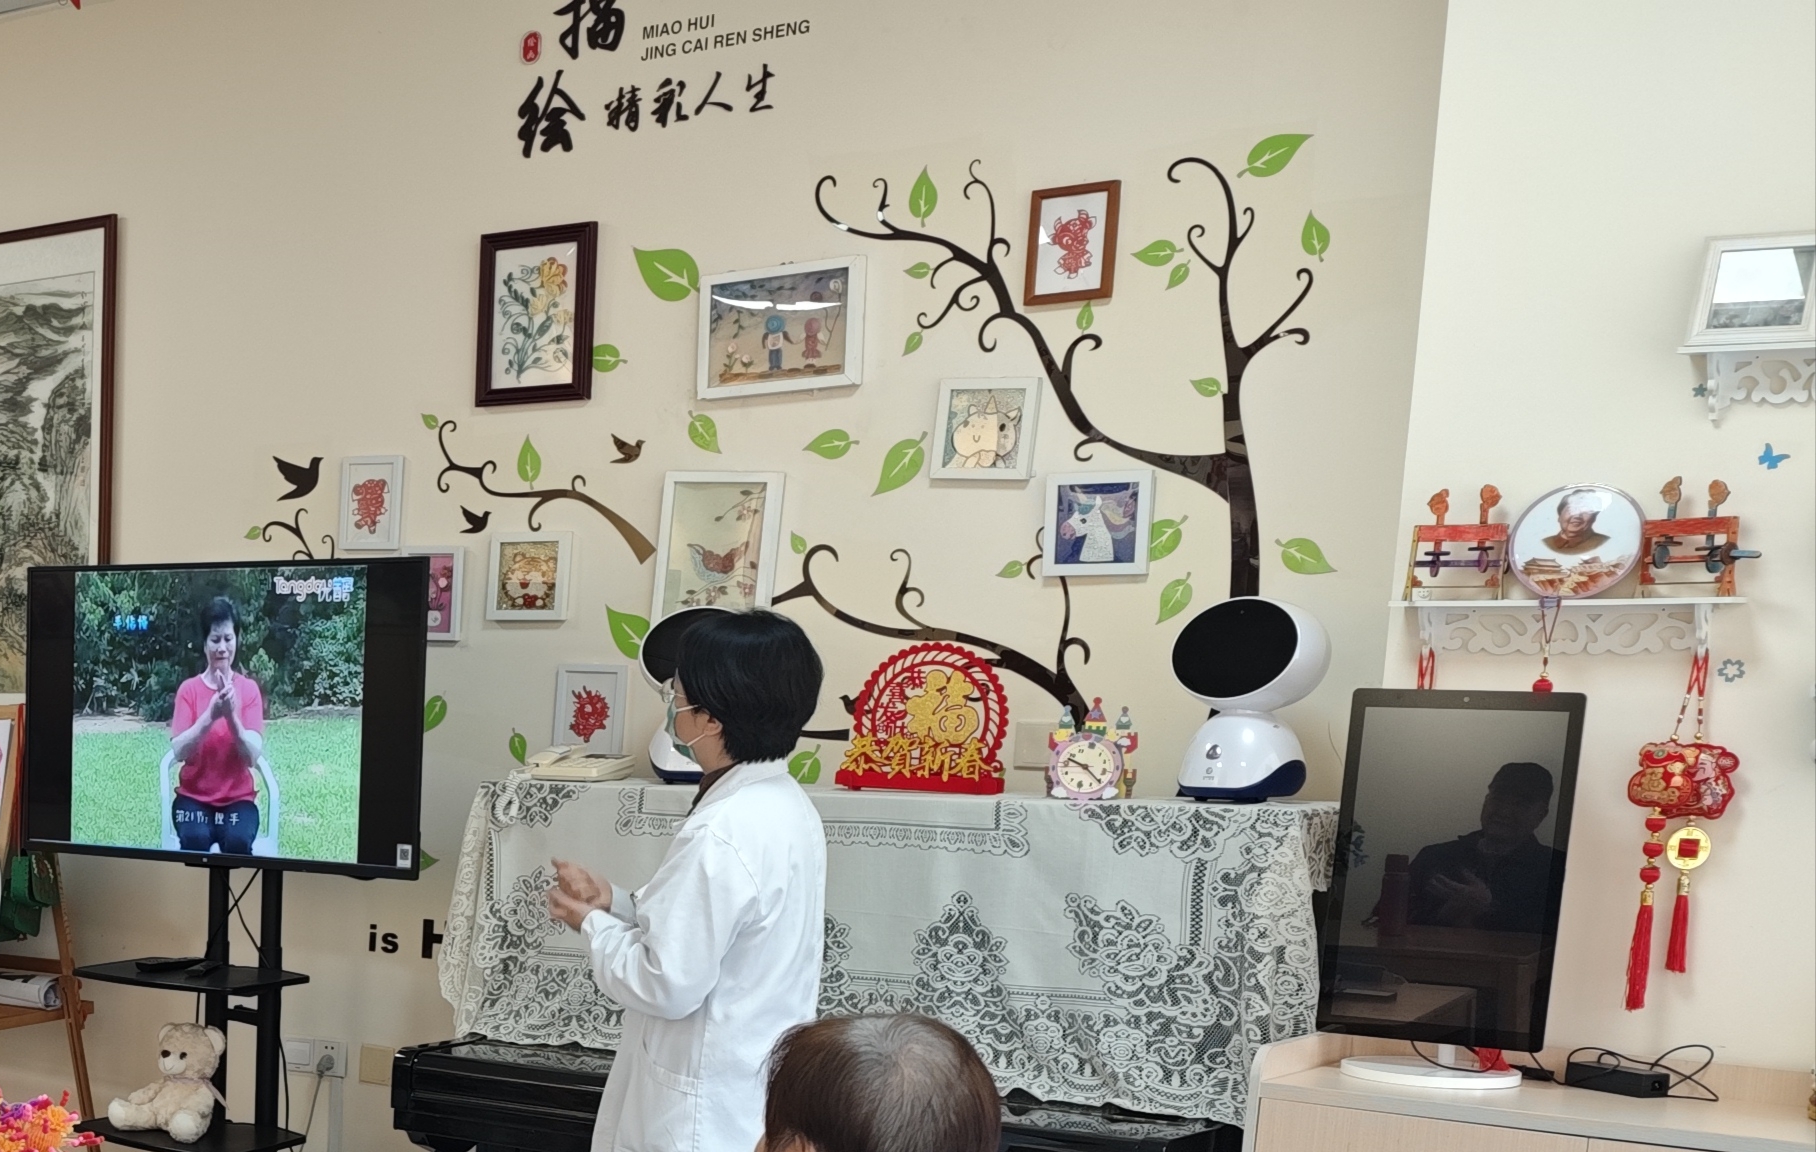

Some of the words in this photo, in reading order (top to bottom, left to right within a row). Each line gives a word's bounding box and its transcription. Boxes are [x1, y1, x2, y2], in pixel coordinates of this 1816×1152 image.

[641, 42, 677, 62] JING
[682, 37, 709, 55] CAI
[714, 30, 747, 49] REN
[752, 20, 811, 43] SHENG
[642, 17, 683, 40] MIAO
[687, 14, 715, 33] HUI
[604, 63, 776, 133] 精彩人生
[368, 923, 399, 954] is
